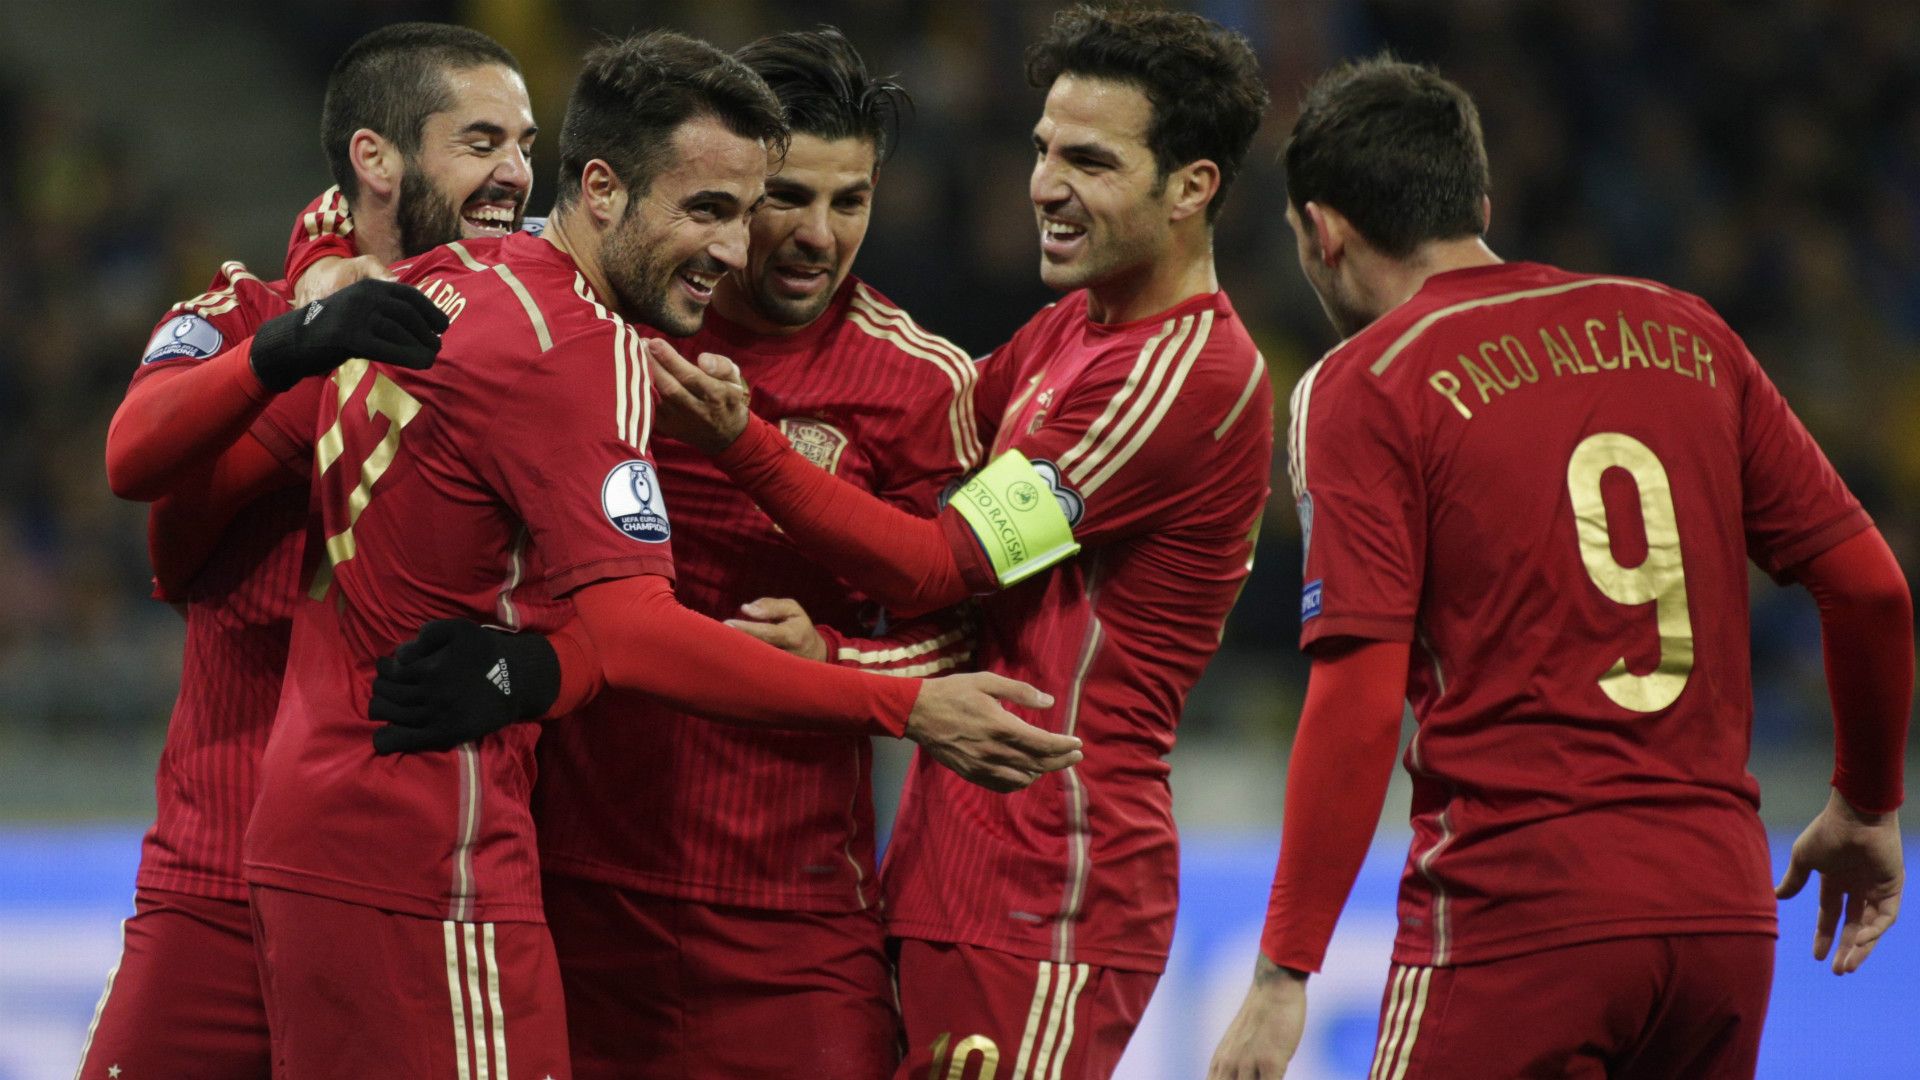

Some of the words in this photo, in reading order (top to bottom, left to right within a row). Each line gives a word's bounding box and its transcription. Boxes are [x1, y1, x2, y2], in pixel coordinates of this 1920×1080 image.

[1428, 333, 1540, 421] PACO
[1538, 309, 1718, 389] ALCÁCER
[973, 488, 993, 508] TO
[988, 507, 1025, 566] RACISM
[1566, 431, 1695, 713] 9
[499, 658, 511, 695] adidas
